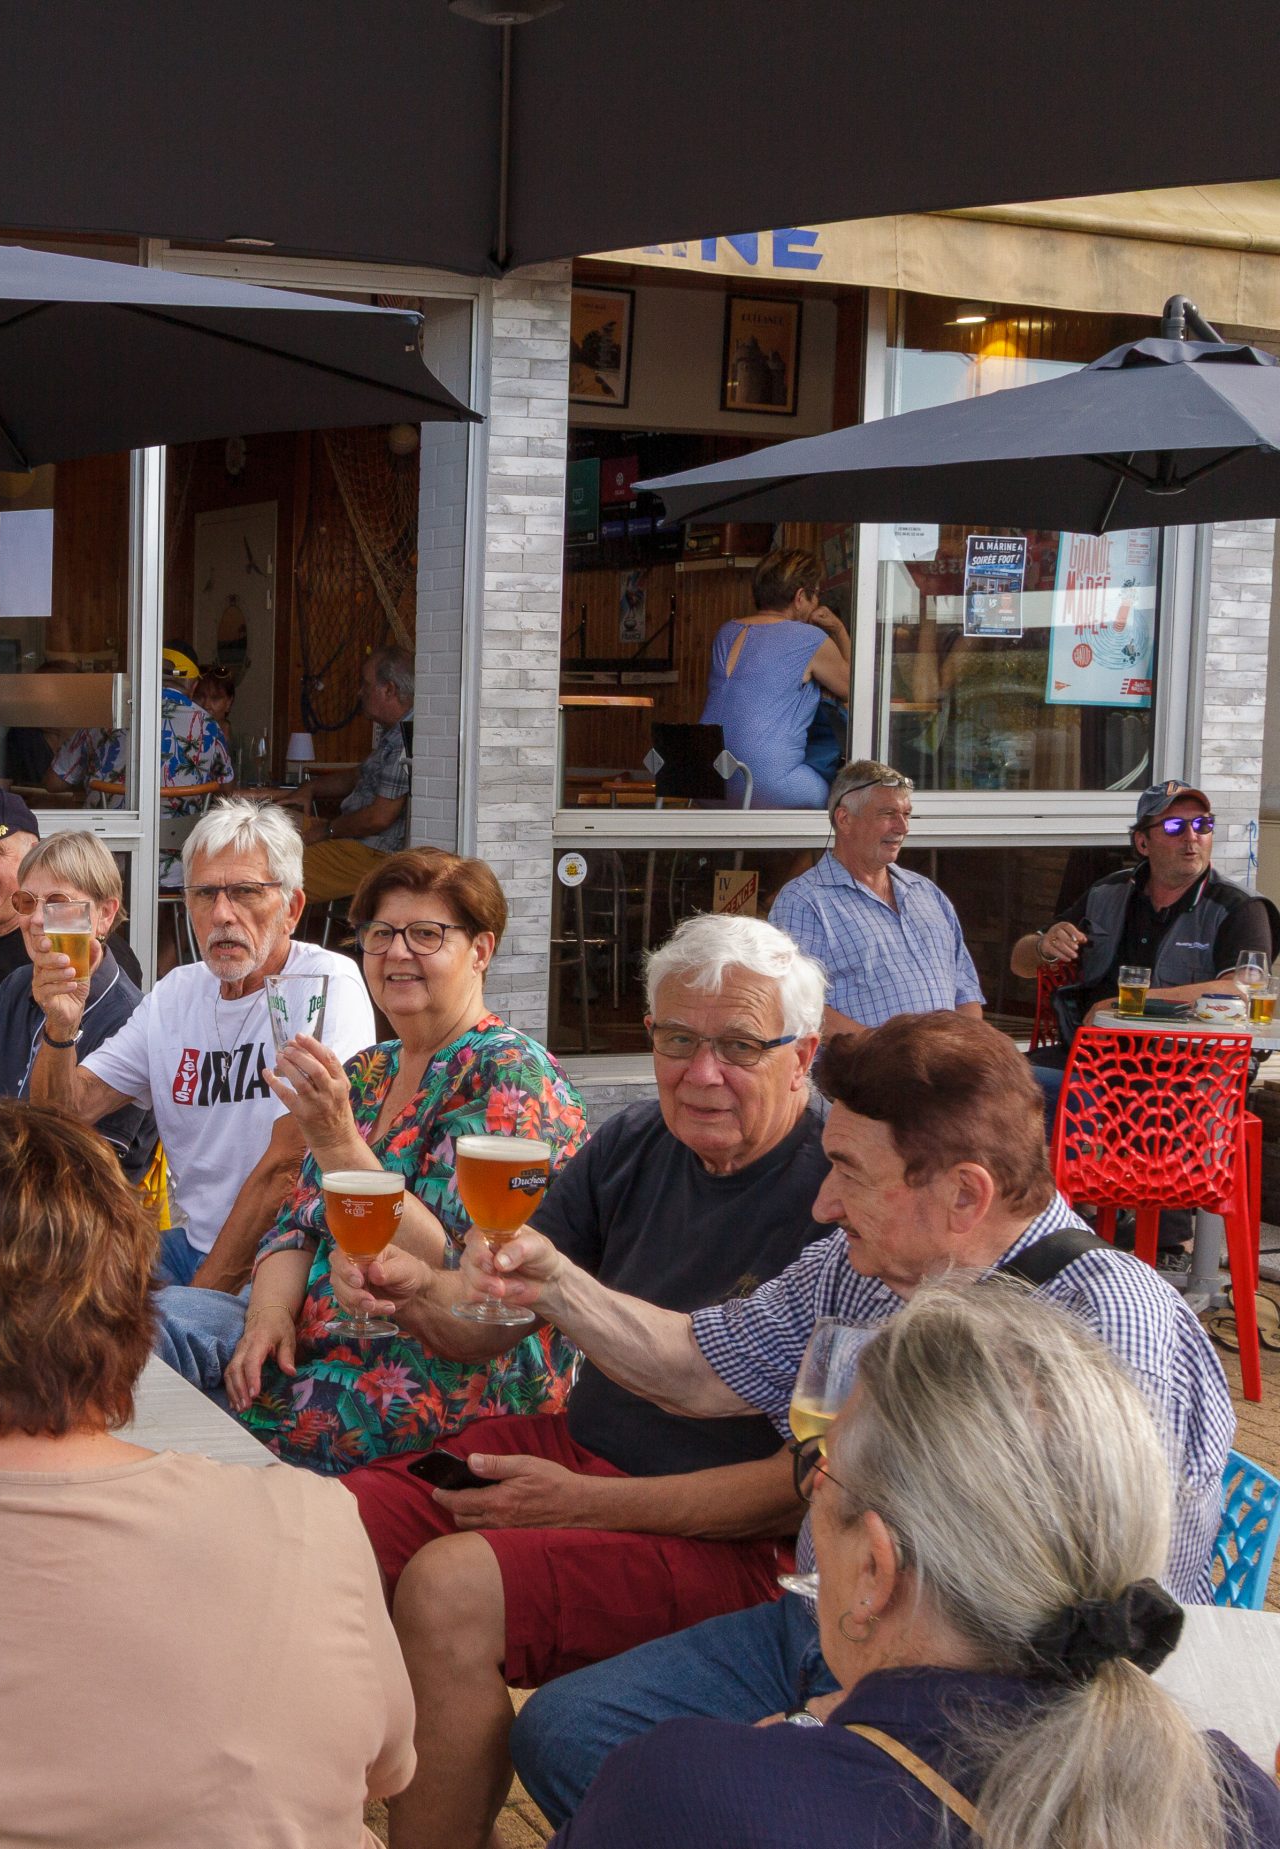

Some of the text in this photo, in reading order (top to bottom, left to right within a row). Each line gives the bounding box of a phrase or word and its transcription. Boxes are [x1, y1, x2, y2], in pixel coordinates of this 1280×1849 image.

[971, 554, 996, 566] SOIRÉE
[998, 554, 1015, 564] FOOT
[975, 541, 1016, 552] LA MARINE
[1069, 532, 1114, 582] GRANDE
[1063, 570, 1111, 636] MARÉE
